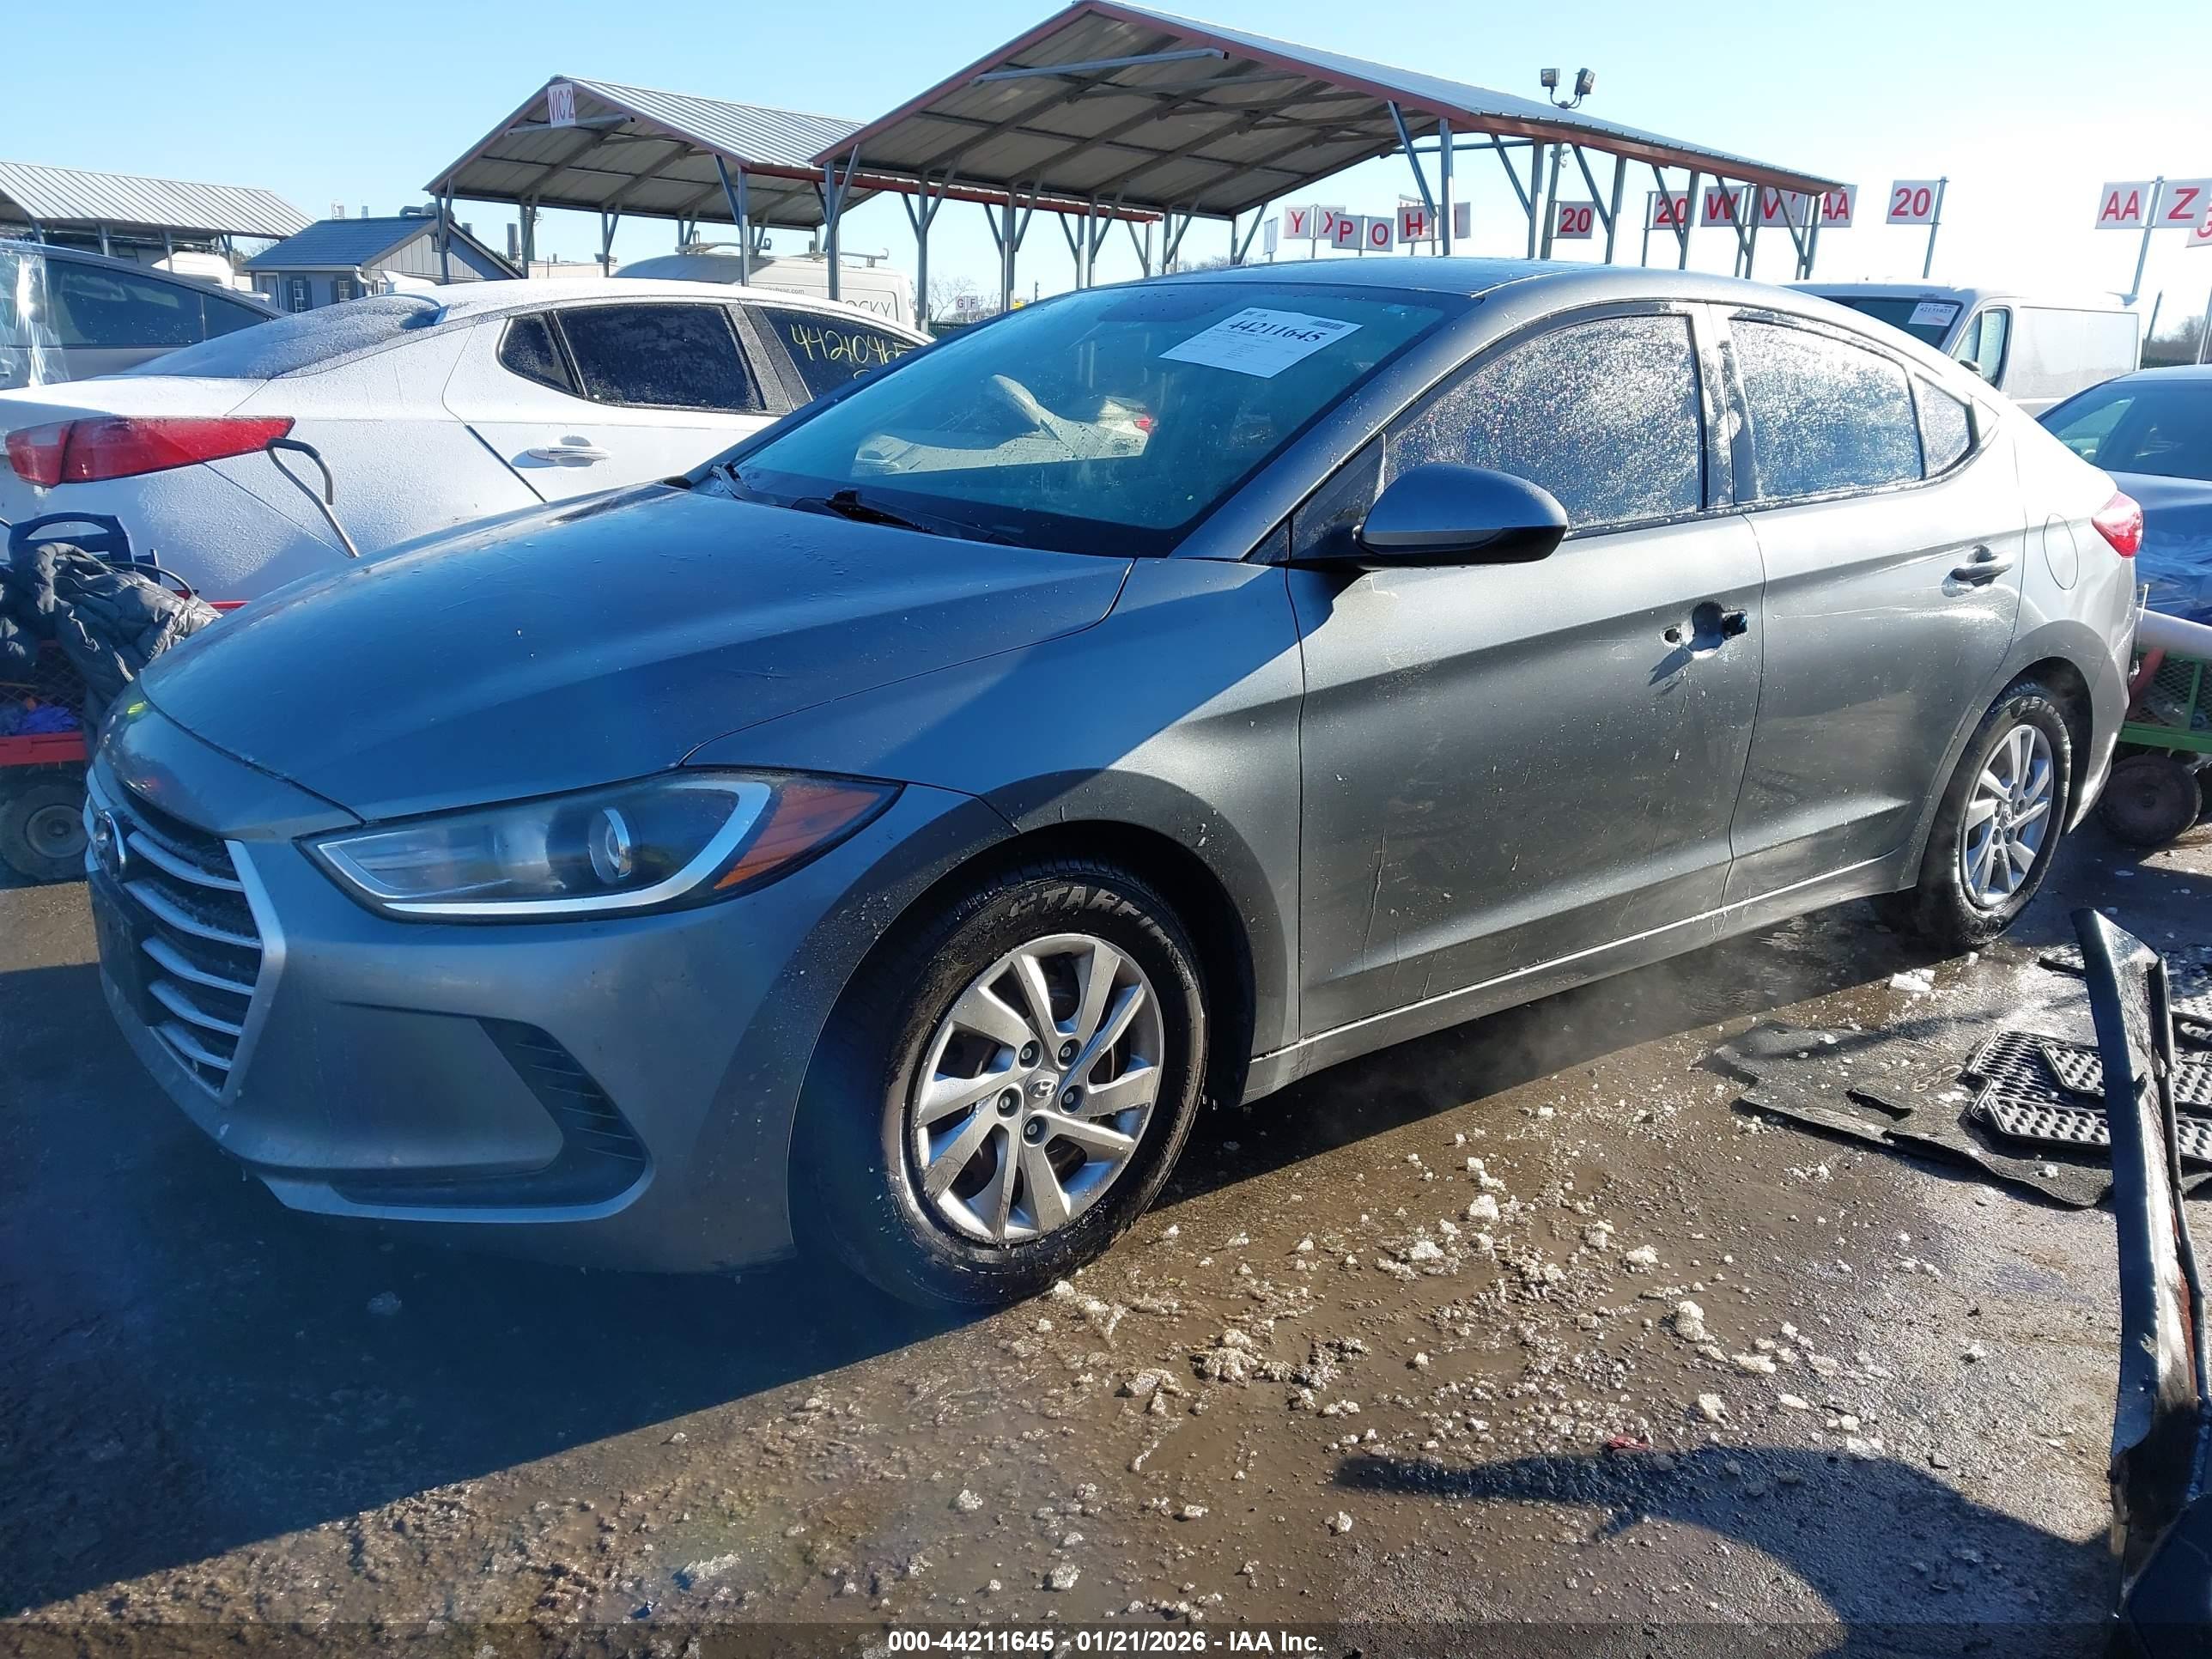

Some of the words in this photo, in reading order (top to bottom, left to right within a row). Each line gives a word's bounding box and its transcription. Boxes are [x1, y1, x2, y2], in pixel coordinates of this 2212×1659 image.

[1656, 197, 1689, 223] 20
[1707, 193, 1739, 220] W
[1822, 191, 1850, 221] AA
[1891, 187, 1931, 216] 20
[2100, 190, 2140, 221] AA
[2166, 187, 2200, 220] Z
[1290, 210, 1306, 234] Y
[1339, 220, 1354, 243] P
[1405, 211, 1424, 237] H
[1560, 207, 1592, 233] 20
[1371, 222, 1389, 246] O
[957, 298, 964, 308] G
[970, 298, 976, 308] F
[1228, 319, 1328, 343] 44211645
